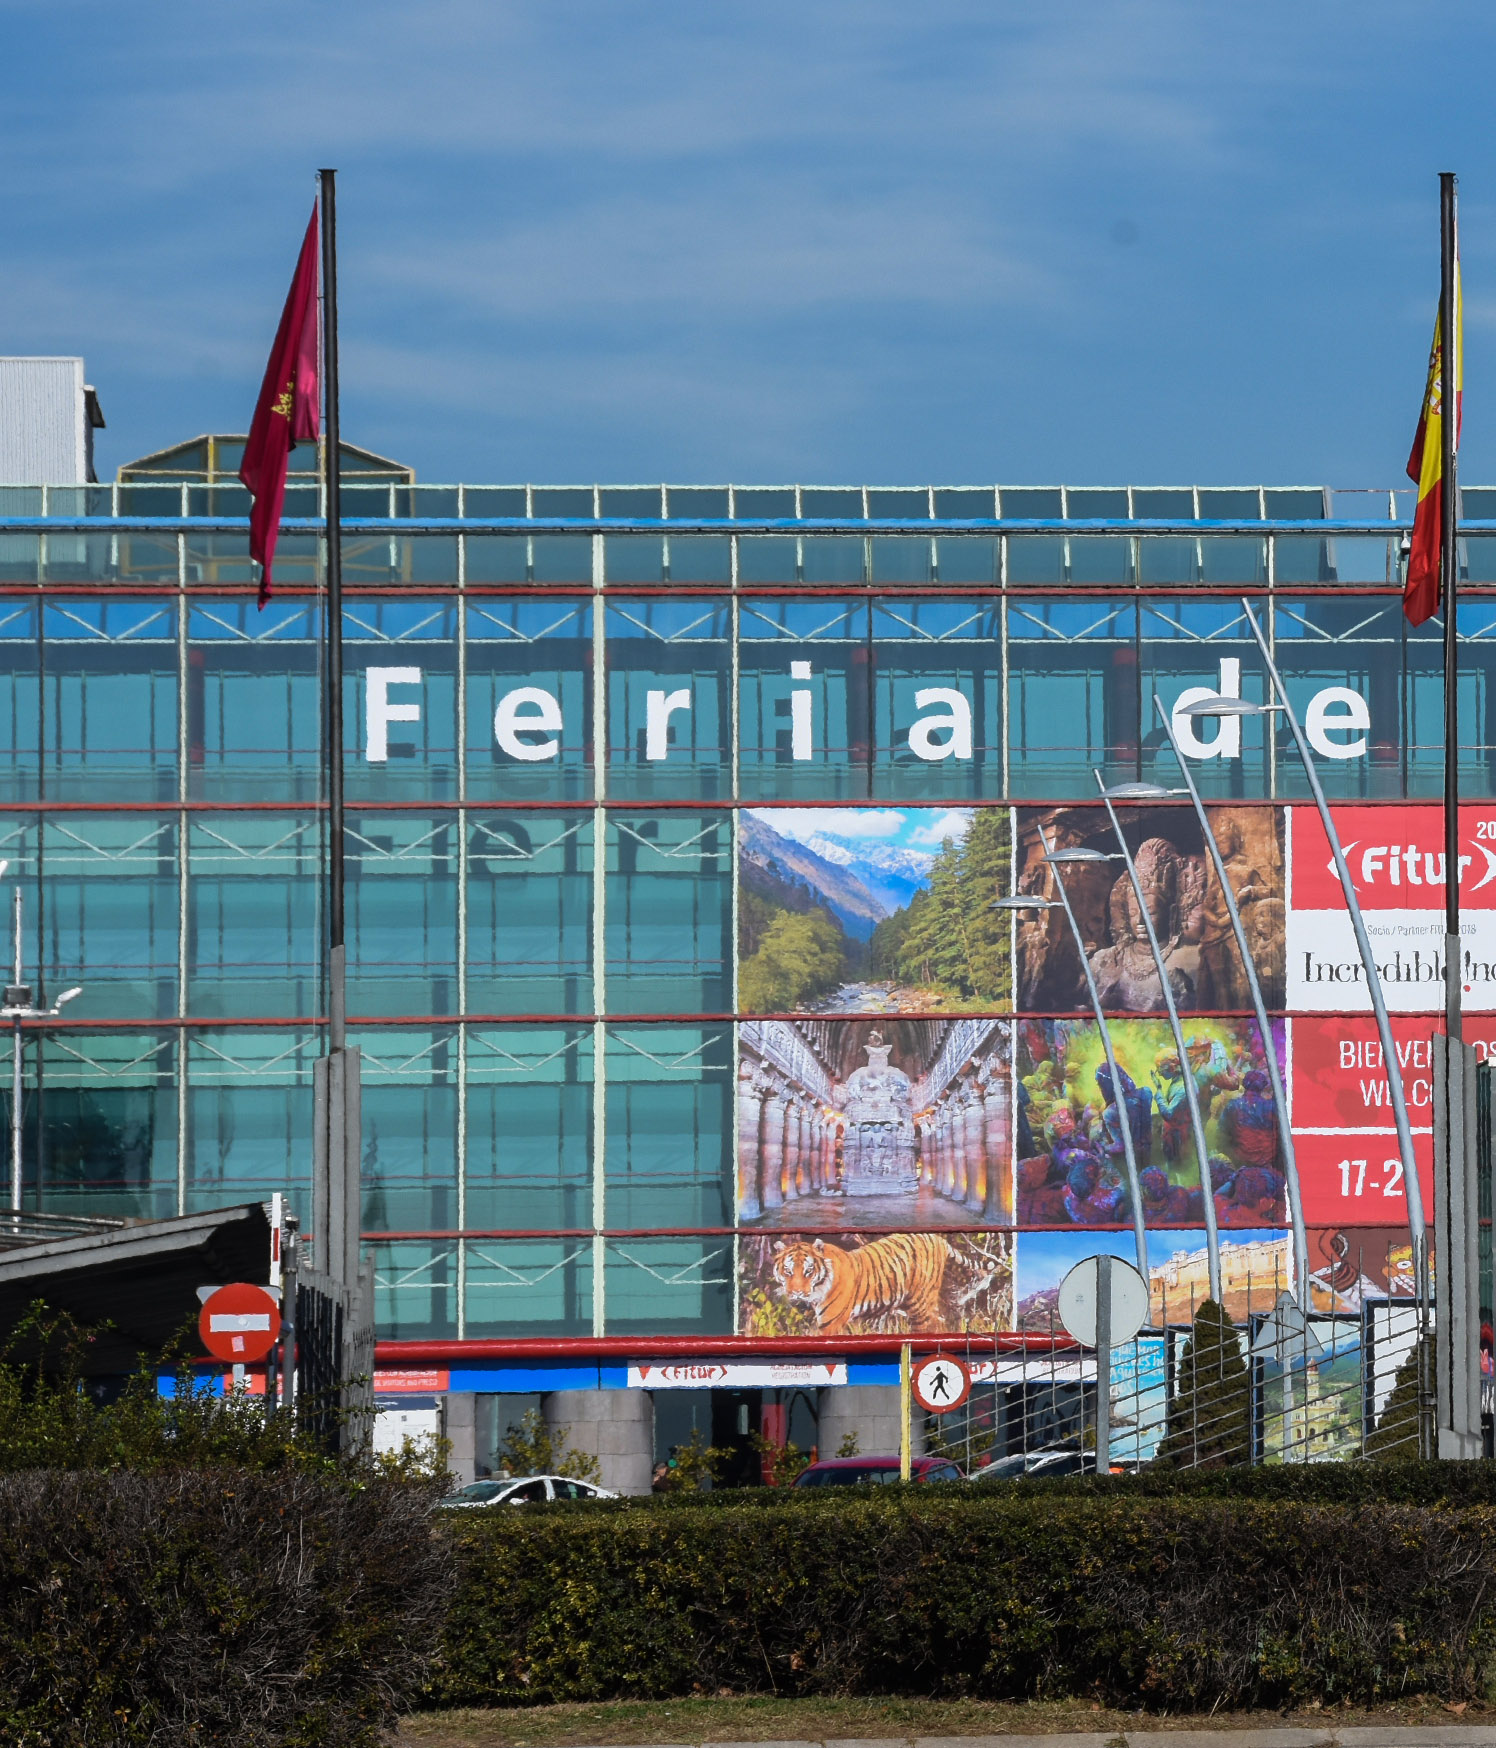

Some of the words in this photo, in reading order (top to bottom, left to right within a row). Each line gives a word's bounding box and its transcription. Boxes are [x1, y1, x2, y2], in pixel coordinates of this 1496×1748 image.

[366, 661, 971, 761] Feria
[1172, 657, 1370, 760] de
[1361, 844, 1472, 885] Fitur
[1338, 1160, 1404, 1196] 17-2
[673, 1363, 717, 1380] Fitur
